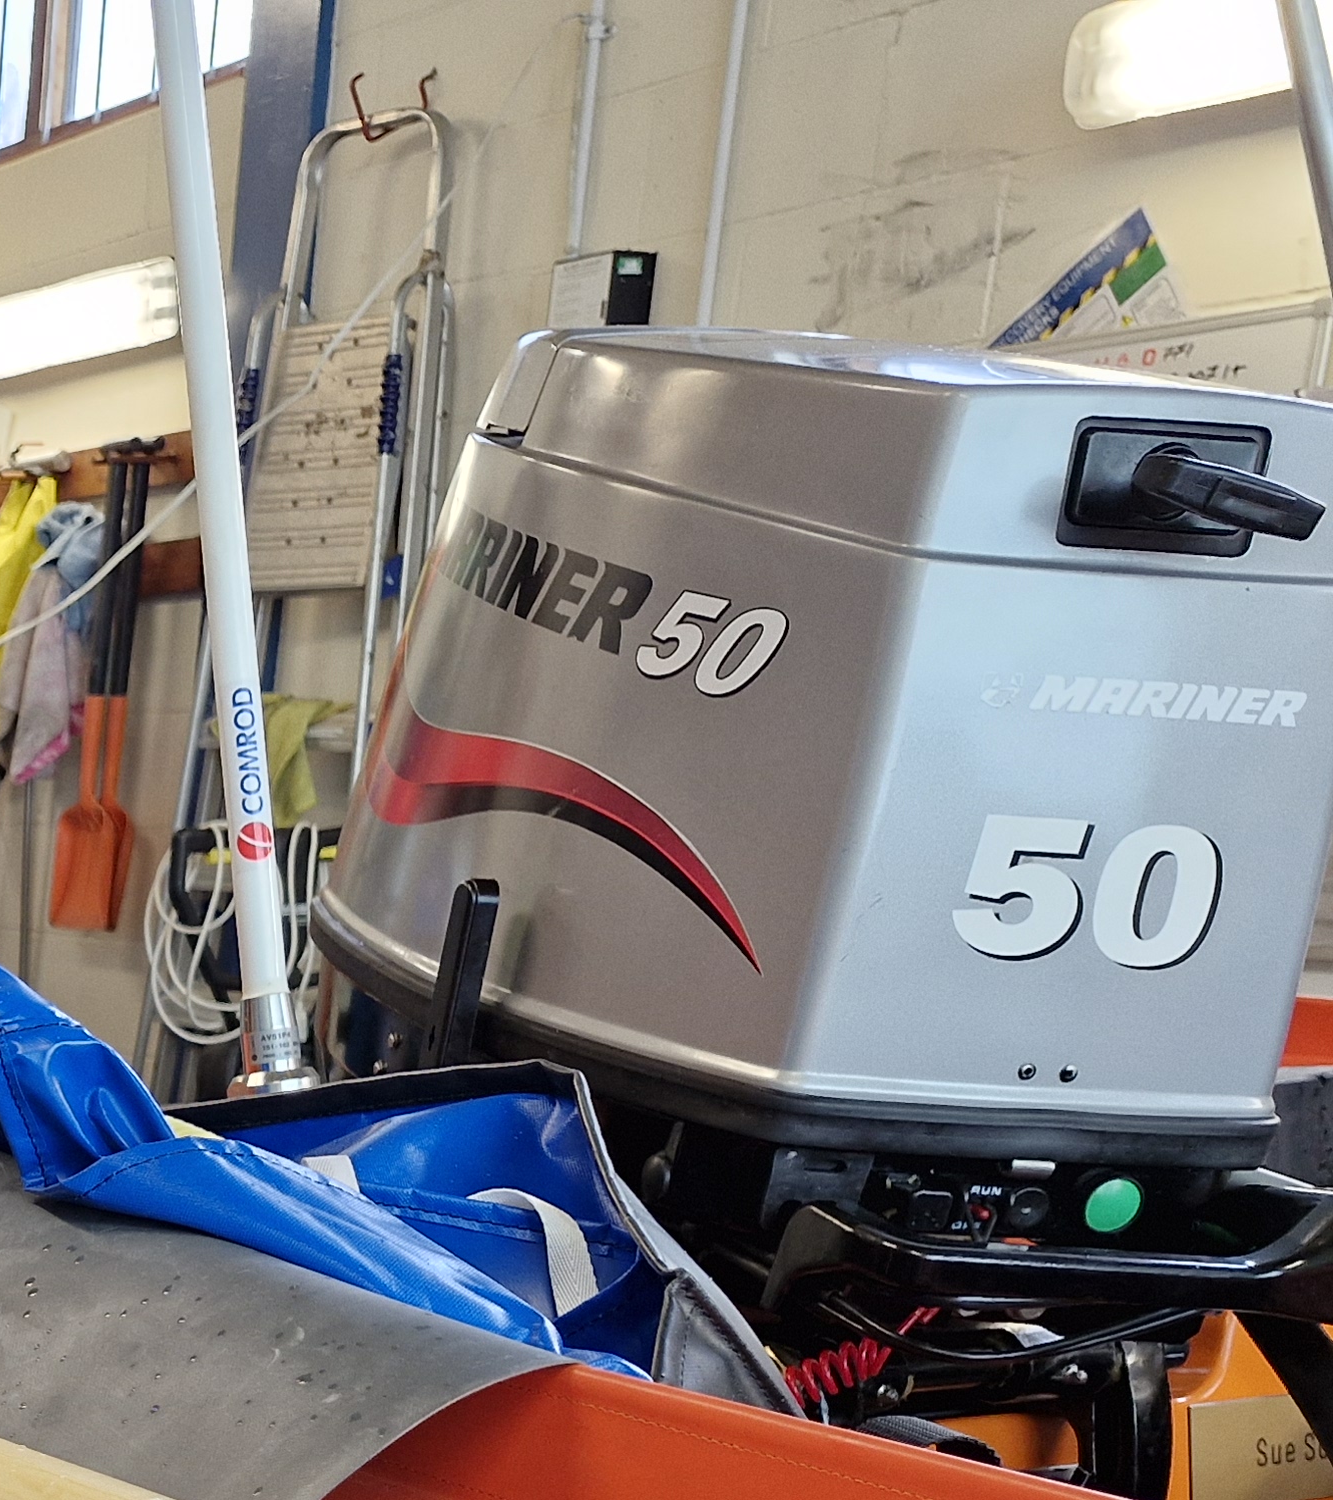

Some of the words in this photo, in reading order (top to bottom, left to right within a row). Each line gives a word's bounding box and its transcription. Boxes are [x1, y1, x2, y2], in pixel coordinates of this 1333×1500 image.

[635, 590, 789, 697] 50
[1029, 674, 1308, 728] MARINER
[232, 687, 263, 816] COMROD
[952, 814, 1223, 970] 50
[970, 1185, 1003, 1197] RUN
[1257, 1437, 1296, 1466] Sue
